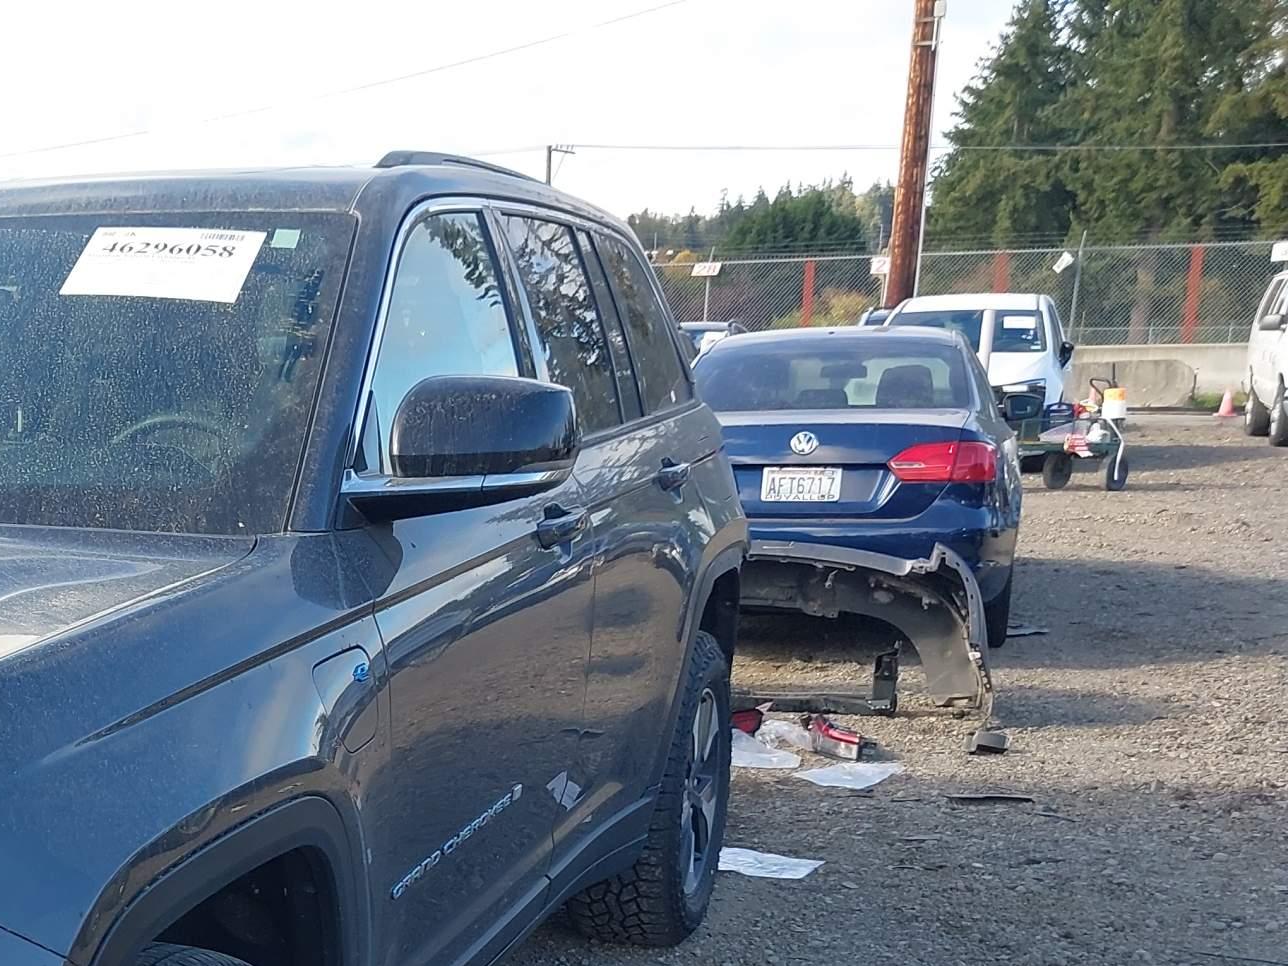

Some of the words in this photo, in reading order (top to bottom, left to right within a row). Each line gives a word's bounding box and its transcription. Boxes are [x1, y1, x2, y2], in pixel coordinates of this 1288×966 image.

[102, 241, 236, 258] 46296058
[768, 477, 836, 495] AFT6717
[392, 850, 441, 899] GRAND
[442, 793, 512, 856] CHEROKEE
